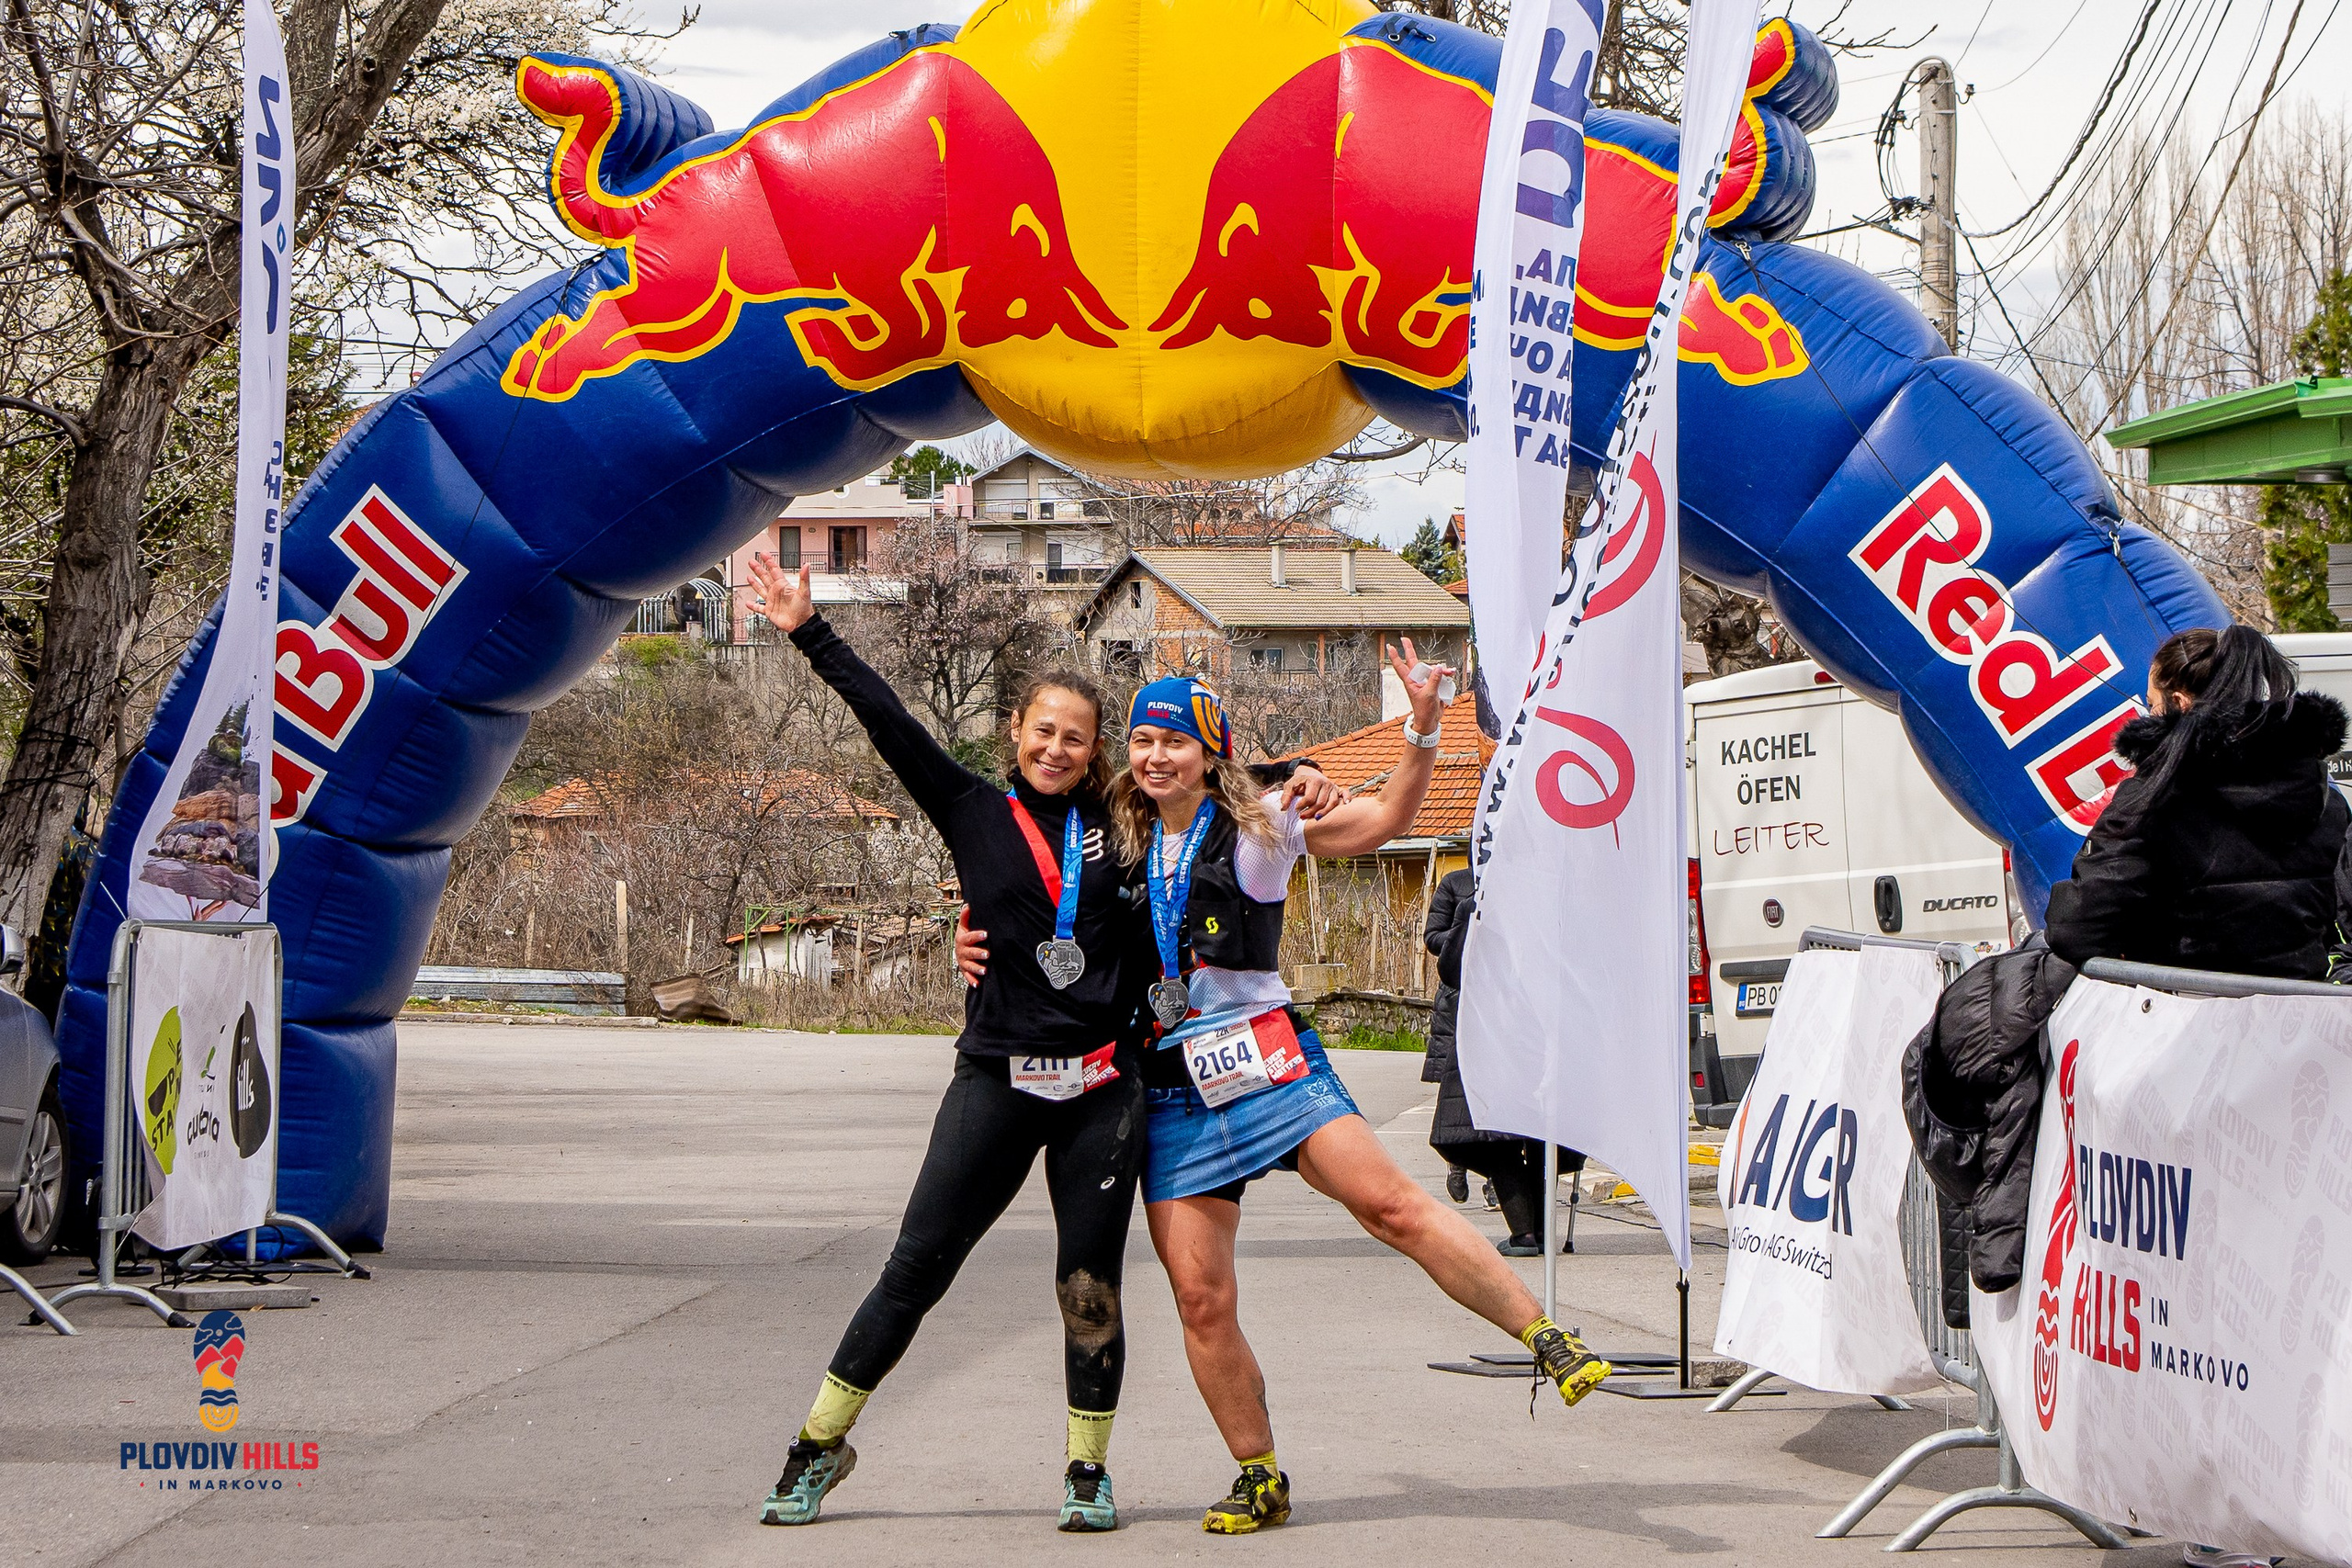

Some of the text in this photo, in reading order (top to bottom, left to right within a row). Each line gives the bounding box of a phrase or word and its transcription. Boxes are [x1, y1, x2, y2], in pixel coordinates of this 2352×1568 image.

[275, 495, 458, 740] Bull
[1859, 474, 2112, 738] Red
[1148, 701, 1183, 715] PLOVDIV
[1720, 732, 1816, 766] KACHEL
[1736, 773, 1801, 806] ÖFEN
[1713, 820, 1830, 857] LEITER
[1766, 905, 1779, 919] FIAT
[1922, 895, 1998, 913] DUCATO
[1747, 987, 1766, 1007] PB
[1046, 1073, 1061, 1081] TRAIL
[1193, 1040, 1253, 1082] 2164
[1202, 1076, 1229, 1091] MARKOVO
[1228, 1071, 1244, 1083] TRAIL
[2078, 1144, 2193, 1261] PLOVDIV
[2070, 1261, 2142, 1373] HILLS
[2150, 1296, 2169, 1327] IN
[2150, 1340, 2250, 1393] MARKOVO
